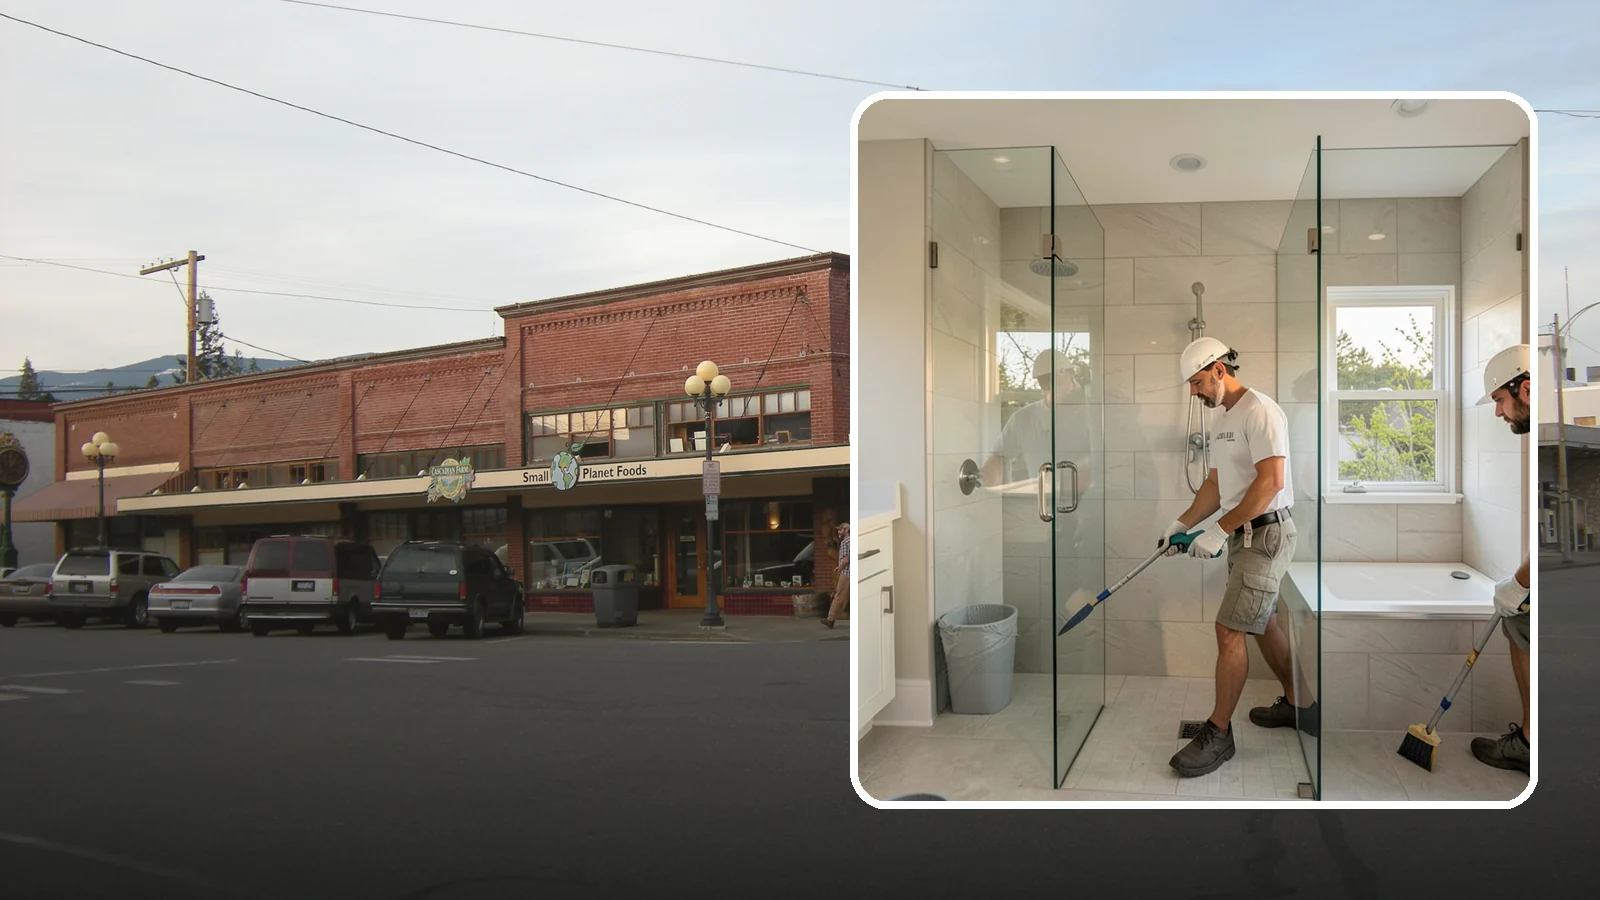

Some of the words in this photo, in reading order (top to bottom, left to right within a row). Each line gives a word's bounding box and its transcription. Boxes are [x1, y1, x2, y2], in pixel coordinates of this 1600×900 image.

[523, 470, 549, 483] Small
[583, 467, 614, 479] Planet
[616, 464, 647, 477] Foods
